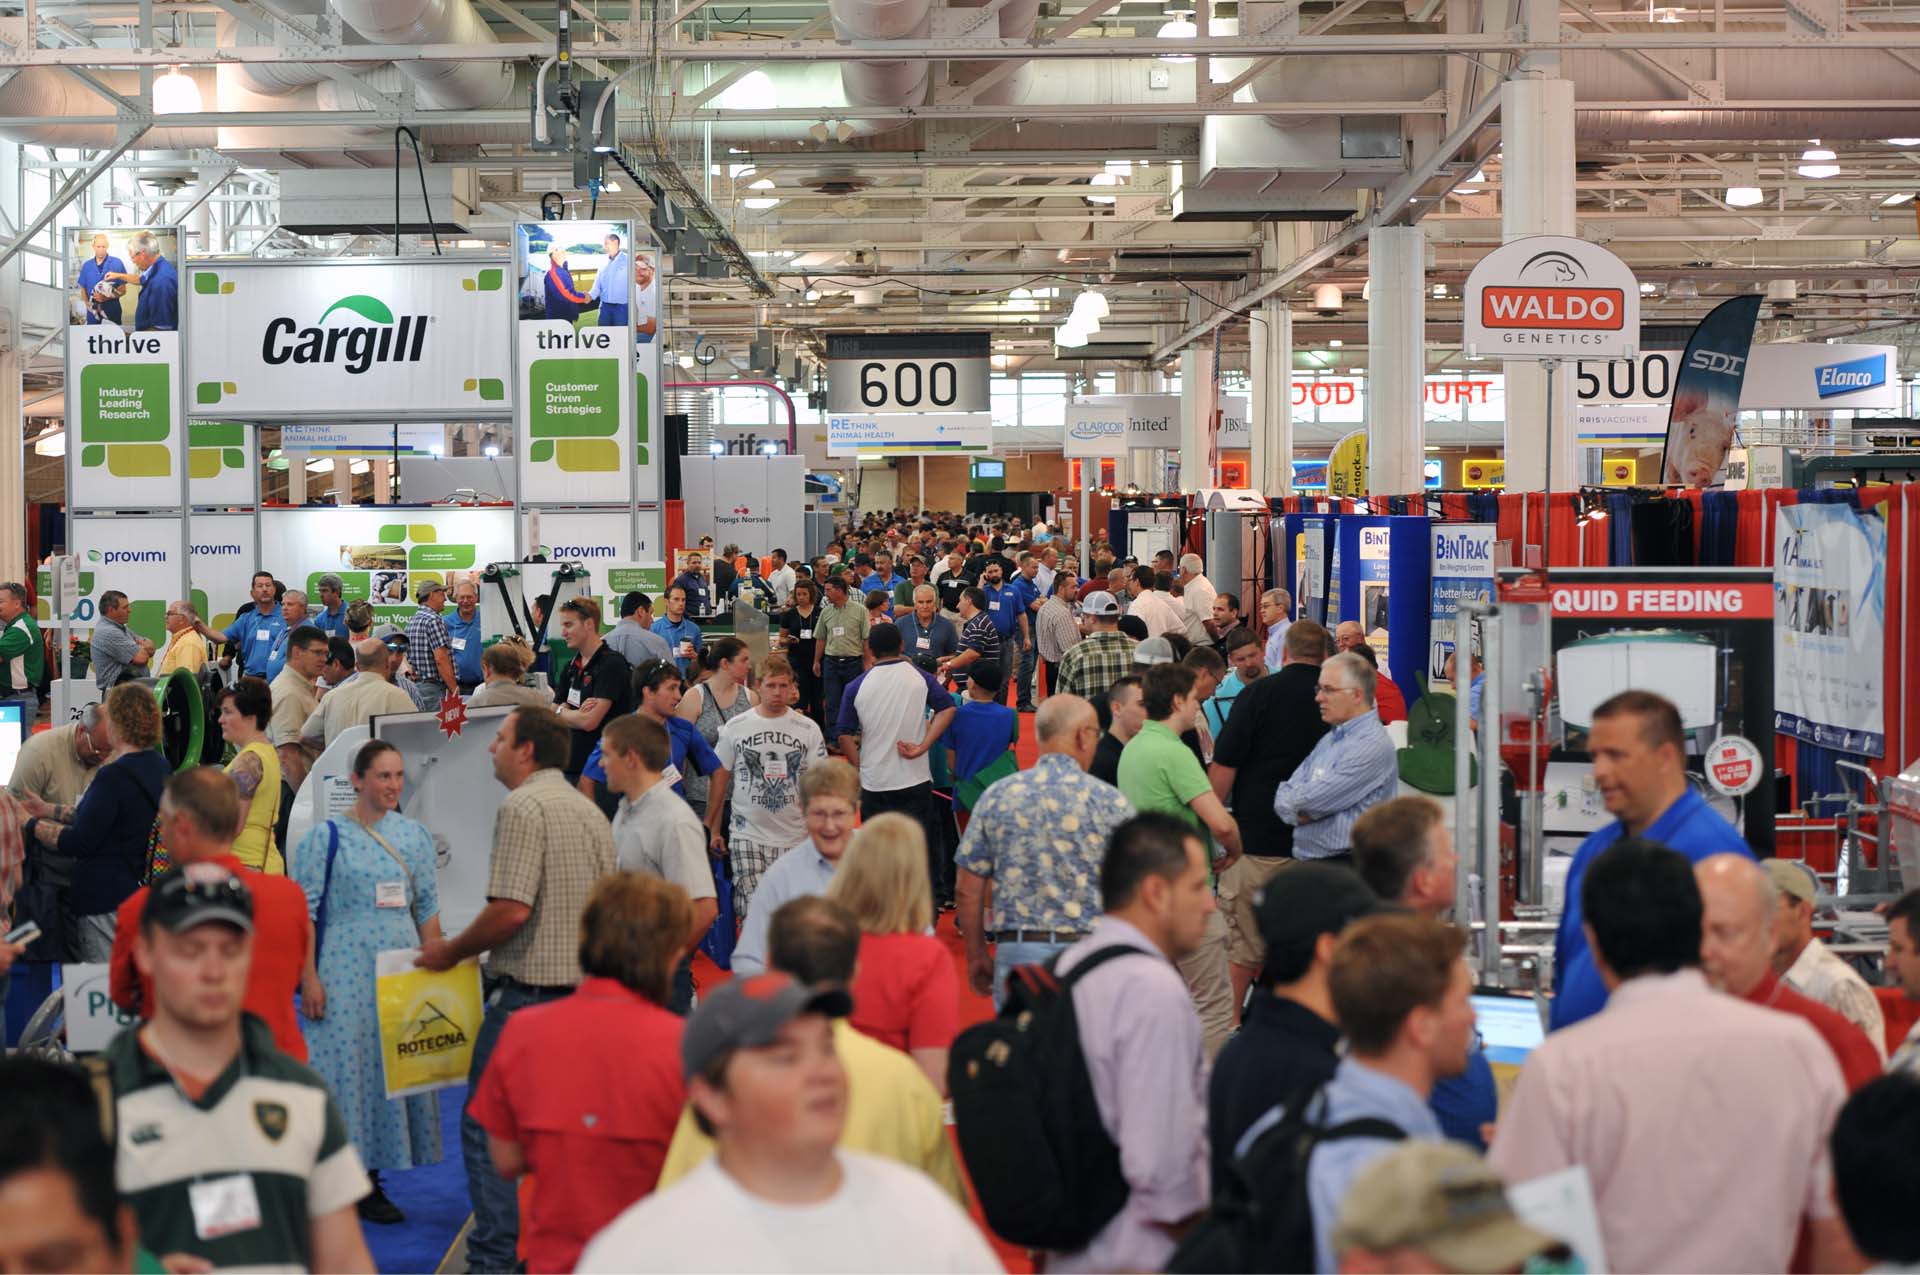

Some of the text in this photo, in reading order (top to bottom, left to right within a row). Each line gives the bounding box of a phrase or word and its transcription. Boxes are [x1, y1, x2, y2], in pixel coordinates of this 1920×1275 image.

[1489, 295, 1614, 321] WALDO
[88, 334, 161, 355] thrive
[262, 315, 428, 374] Cargill
[536, 330, 610, 349] thrive
[1689, 349, 1745, 376] SDI
[1577, 354, 1669, 399] 500
[1820, 368, 1872, 387] Elanco
[545, 382, 599, 392] Customer
[860, 361, 956, 408] 600
[99, 387, 144, 398] Industry
[545, 393, 581, 403] Driven
[1291, 381, 1493, 406] OOD URT
[99, 398, 142, 409] Leading
[545, 404, 602, 415] Strategies
[99, 409, 150, 419] Research
[1579, 416, 1648, 424] RRISVACCINES
[1077, 421, 1124, 432] CLARCOR
[284, 434, 347, 442] ANIMAL HEALTH
[830, 431, 895, 439] ANIMAL HEALTH
[715, 516, 739, 524] Topigs
[104, 550, 166, 565] provimi
[553, 546, 616, 560] provimi
[1440, 588, 1461, 598] better
[1461, 589, 1477, 600] feed
[1552, 589, 1743, 613] QUID FEEDING
[1433, 602, 1457, 613] bin sca
[444, 708, 461, 722] NEW
[736, 731, 809, 758] AMERICAN
[397, 1031, 467, 1056] ROTECNA
